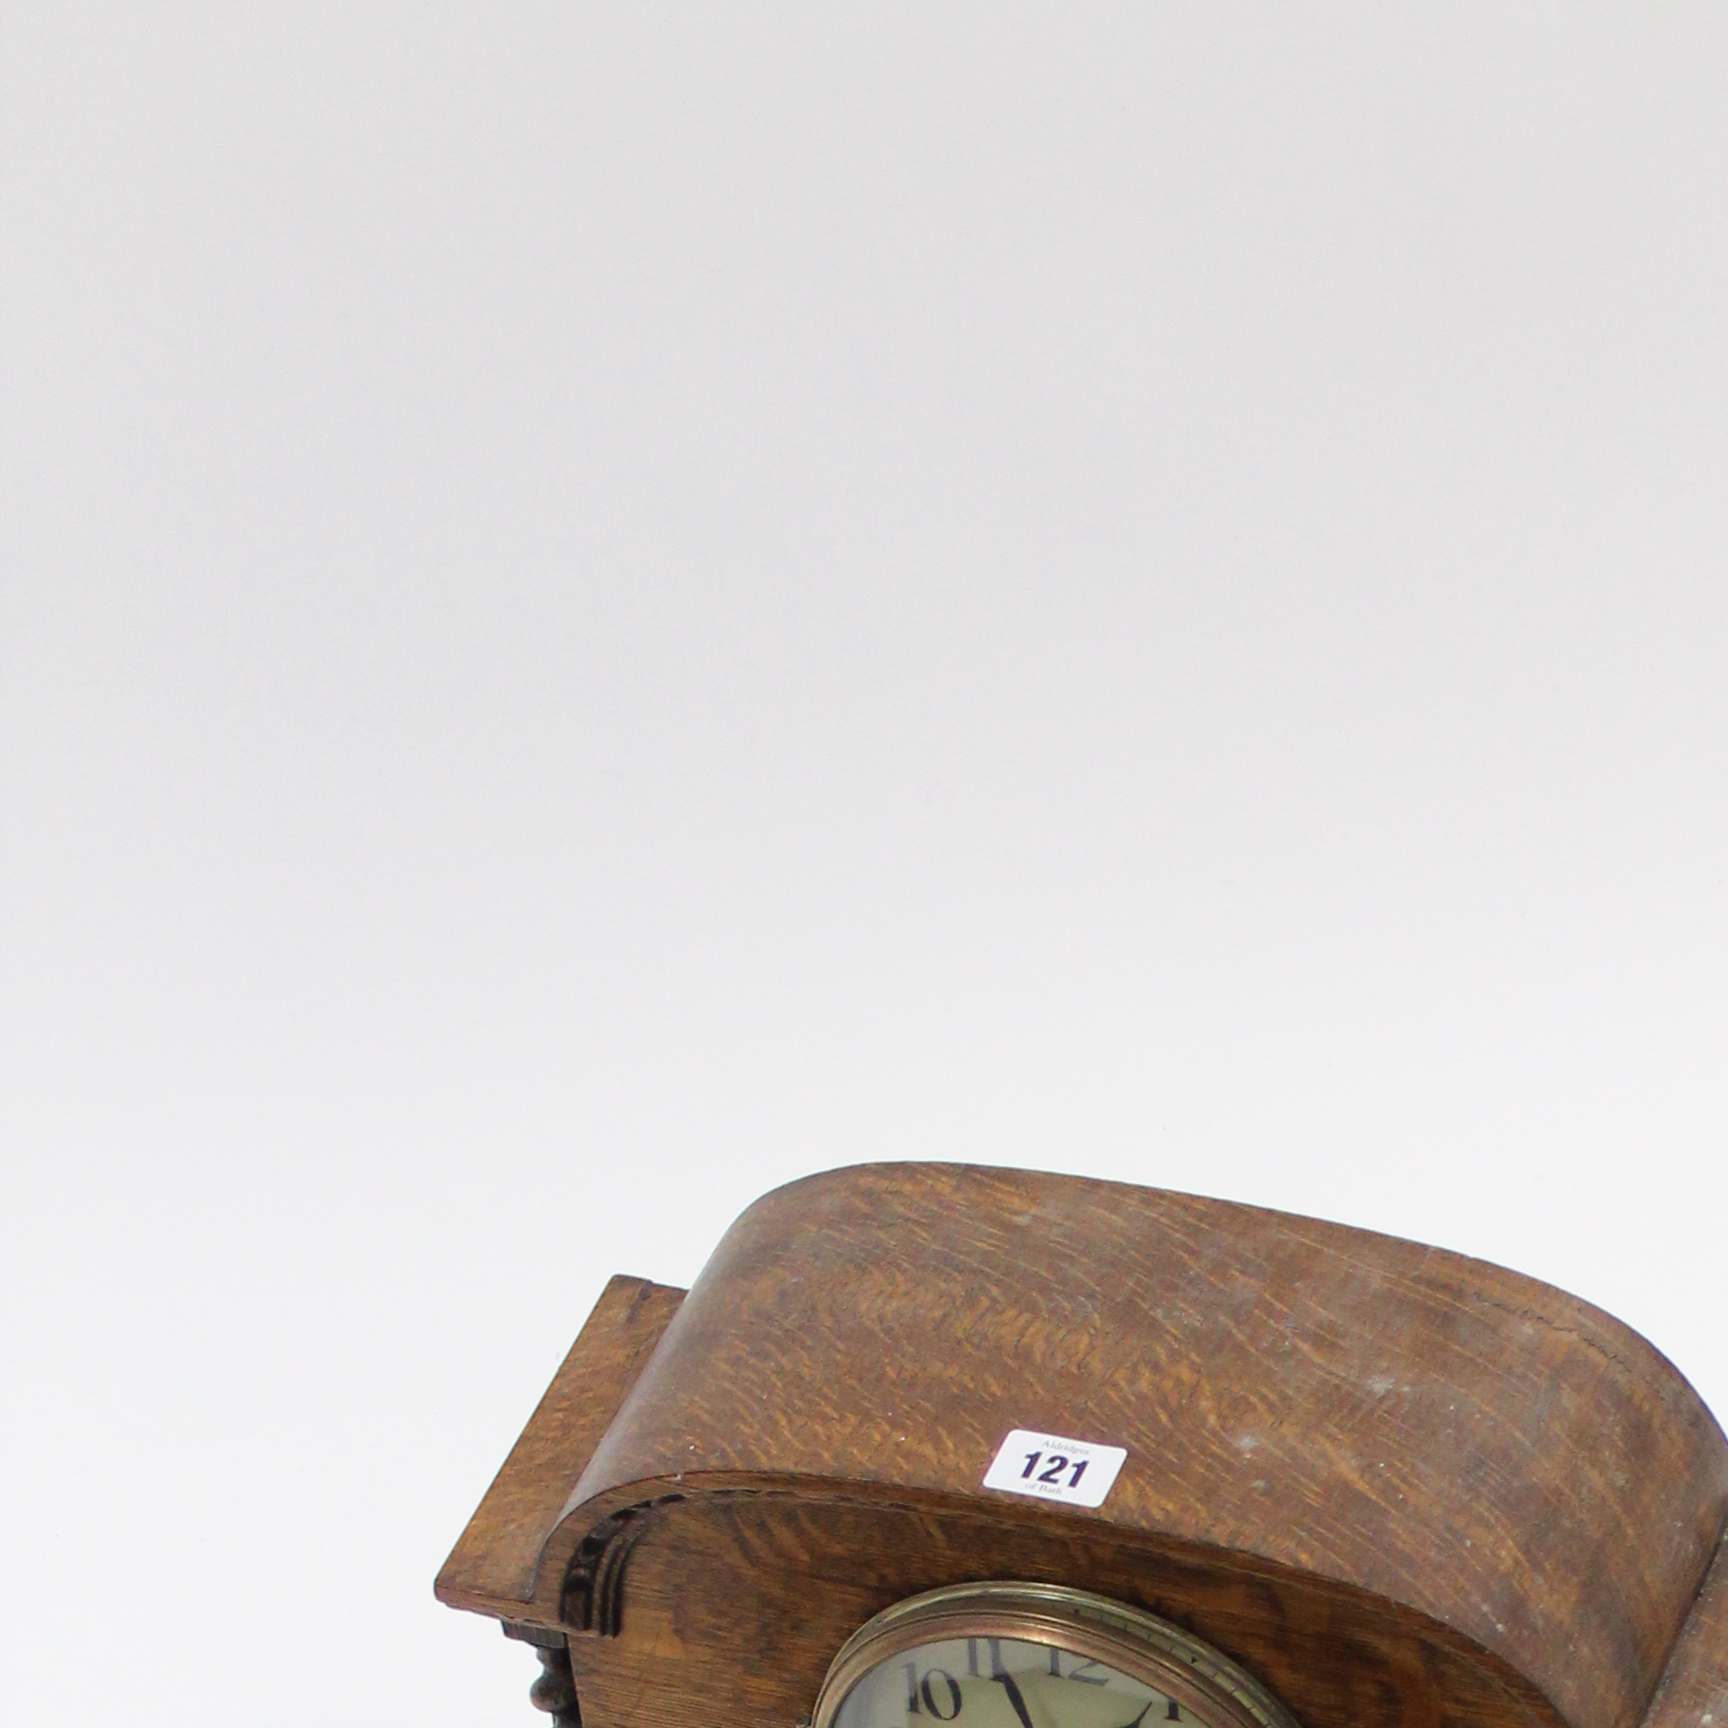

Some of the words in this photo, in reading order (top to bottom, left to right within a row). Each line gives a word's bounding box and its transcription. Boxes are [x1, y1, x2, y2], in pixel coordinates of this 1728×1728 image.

[1041, 1438, 1090, 1455] Aldridges
[1020, 1451, 1090, 1489] 121
[1025, 1482, 1037, 1491] of
[1038, 1483, 1063, 1496] Bath
[902, 1661, 963, 1721] 10
